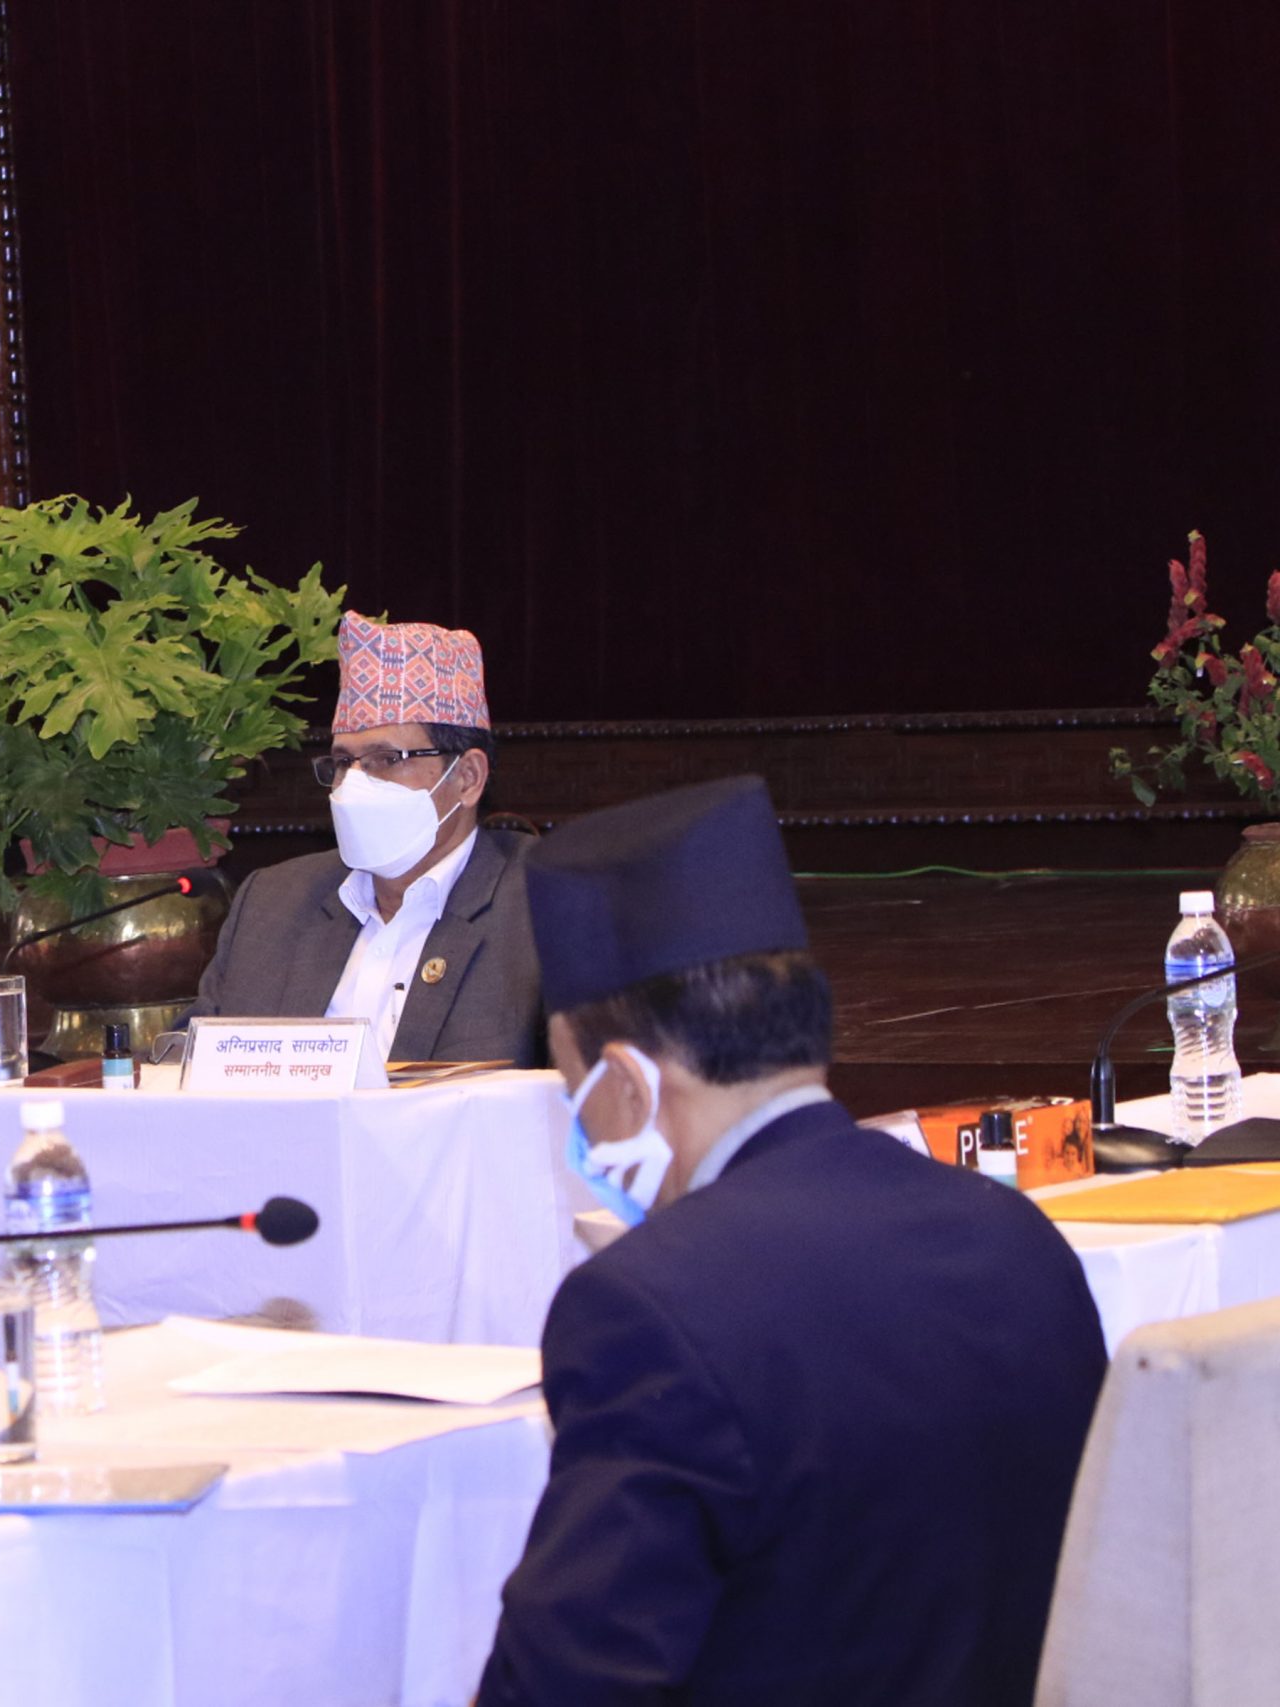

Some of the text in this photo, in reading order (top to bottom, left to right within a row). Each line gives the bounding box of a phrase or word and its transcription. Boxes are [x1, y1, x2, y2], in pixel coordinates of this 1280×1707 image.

[215, 1035, 349, 1054] अग्निप्रसाद सापकोटा
[223, 1061, 333, 1081] सम्माननीय सभामुख
